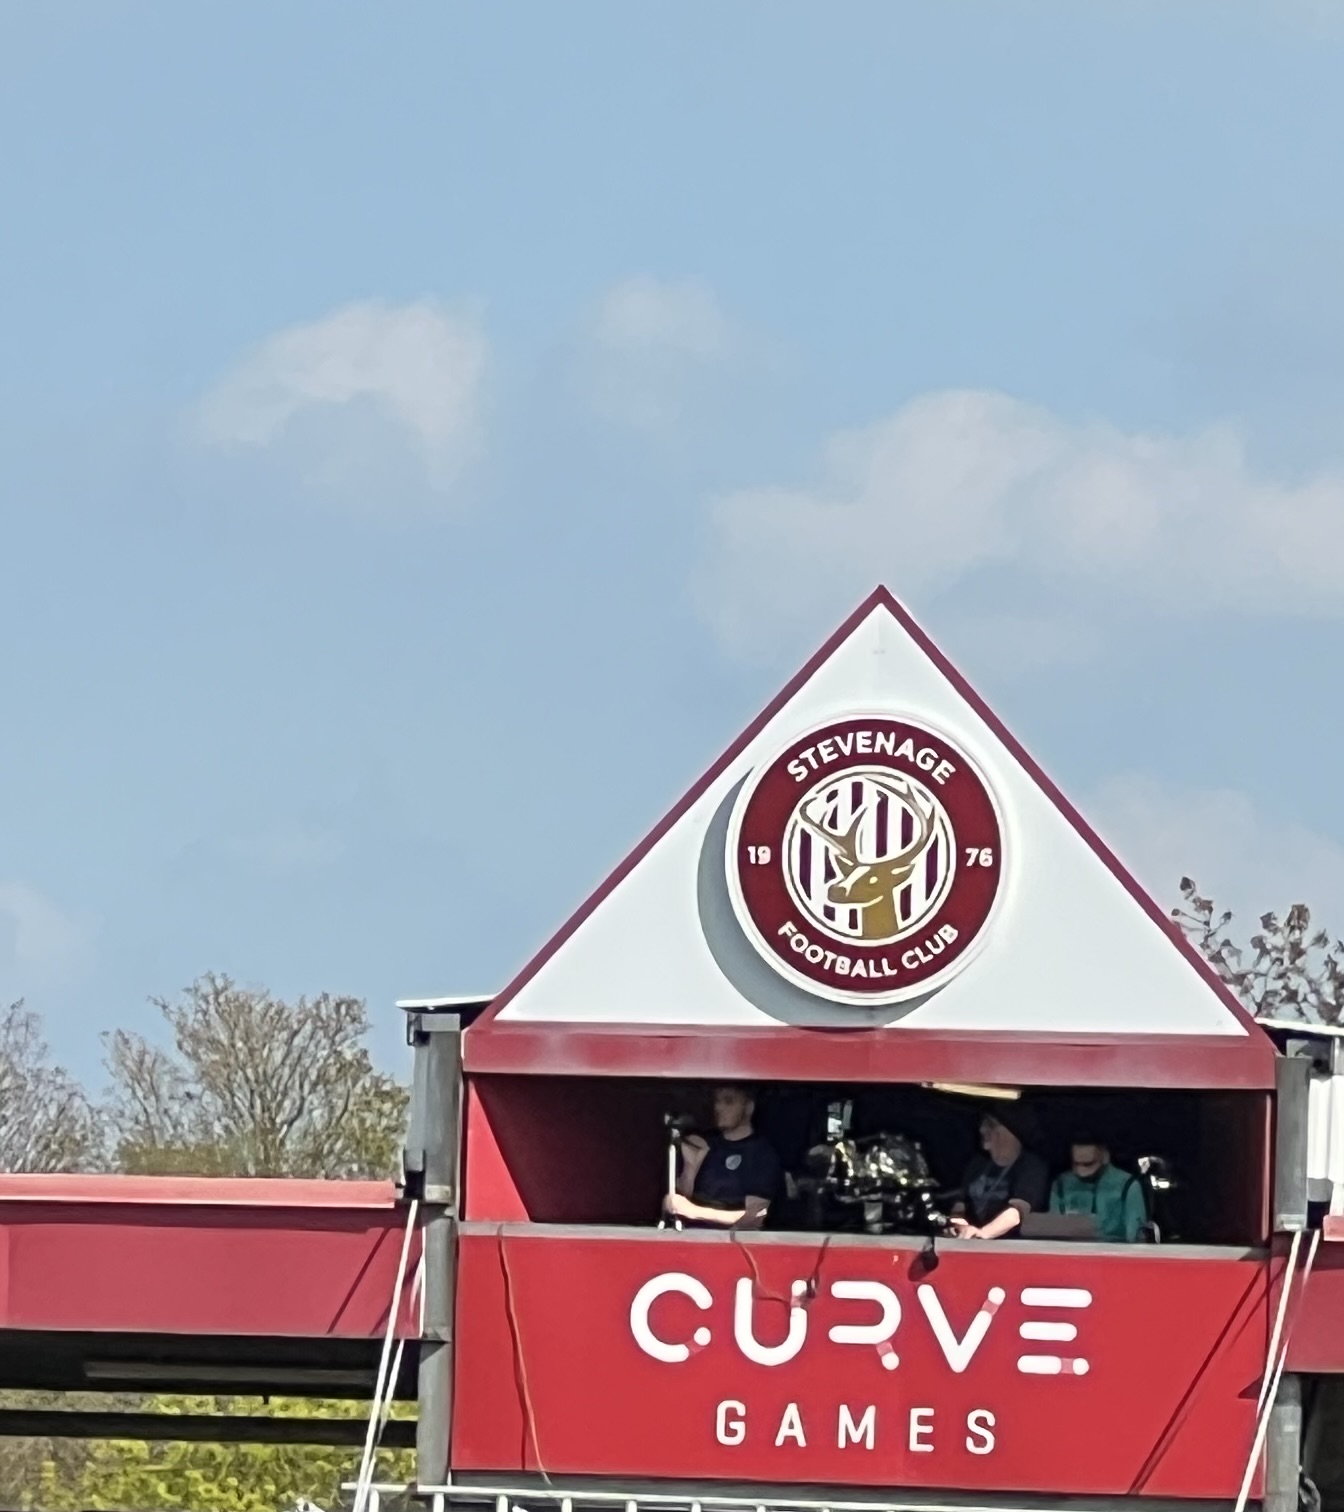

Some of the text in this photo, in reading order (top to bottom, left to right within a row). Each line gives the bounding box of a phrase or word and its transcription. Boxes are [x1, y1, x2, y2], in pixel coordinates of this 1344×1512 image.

[787, 731, 956, 785] STEVENAGE
[747, 845, 772, 865] 19
[965, 847, 993, 867] 76
[777, 920, 959, 978] FOOTBALL CLUB
[630, 1272, 1092, 1375] CURVE
[715, 1399, 996, 1456] GAMES
